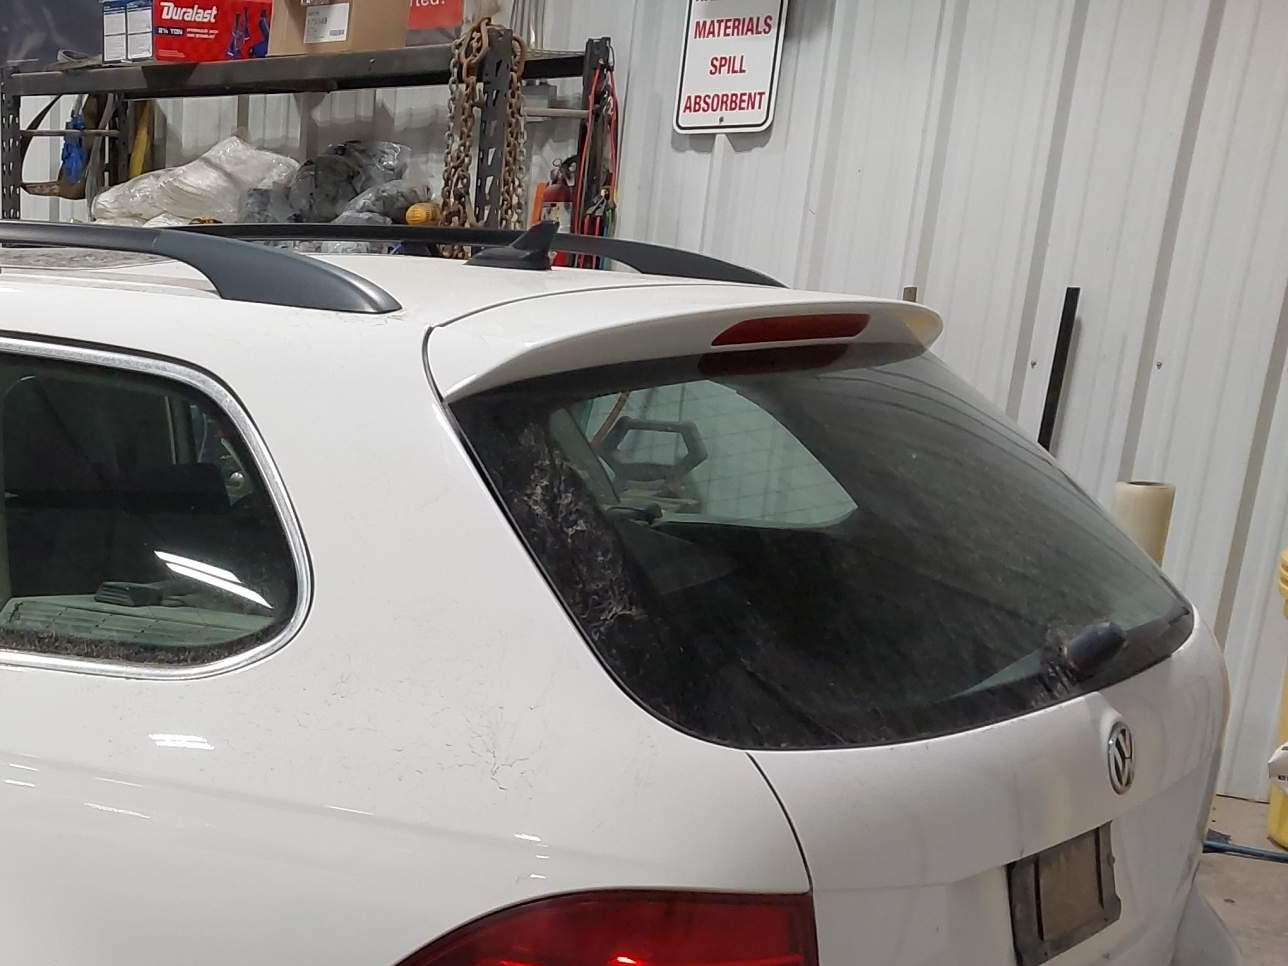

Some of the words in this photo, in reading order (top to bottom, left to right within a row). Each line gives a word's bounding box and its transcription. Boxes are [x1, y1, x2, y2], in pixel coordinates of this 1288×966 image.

[159, 1, 218, 23] Duralast
[694, 15, 773, 39] MATERIALS
[709, 55, 747, 76] SPILL
[683, 91, 766, 113] ABSORBENT
